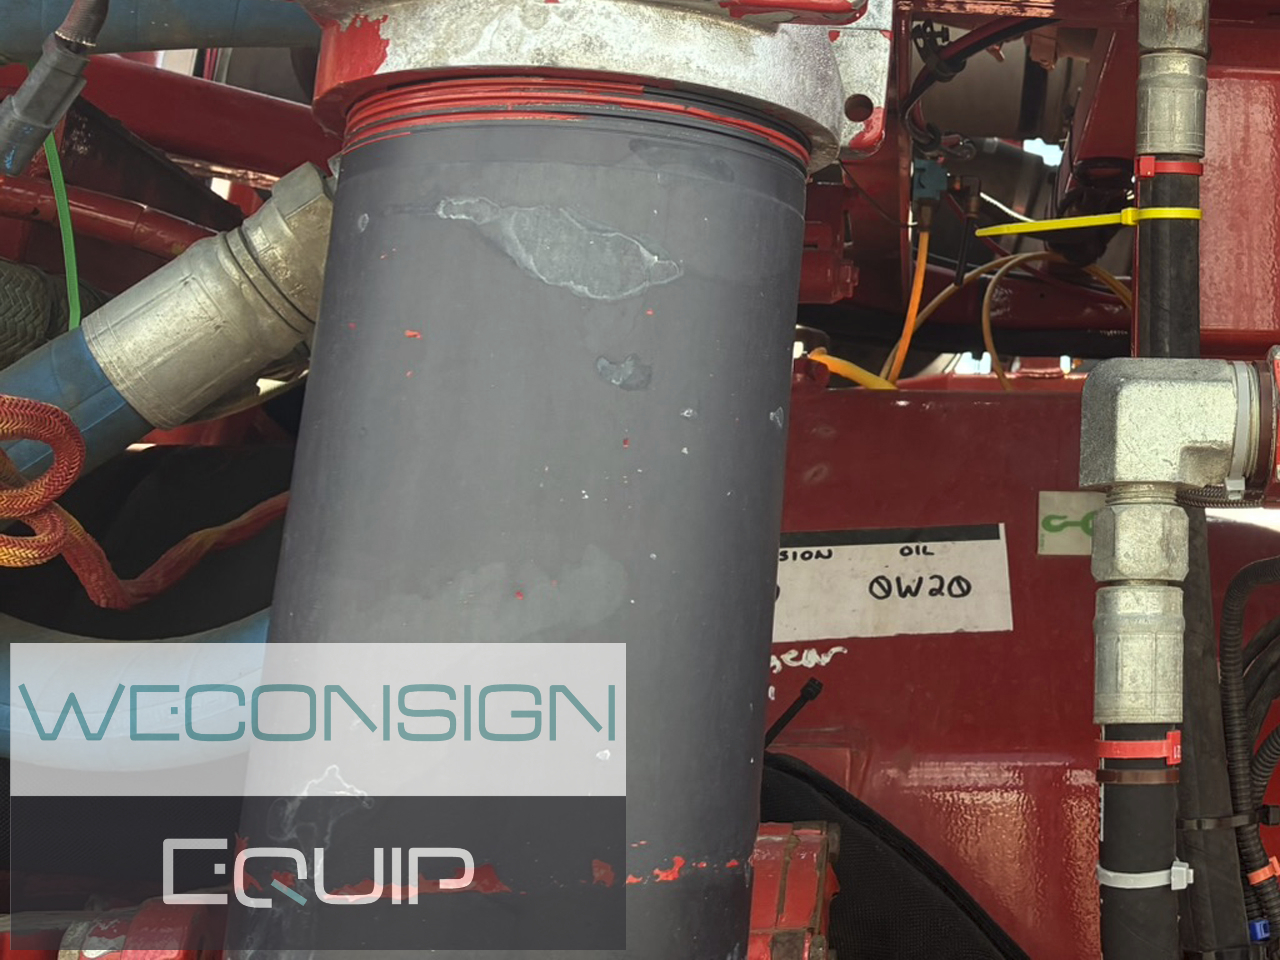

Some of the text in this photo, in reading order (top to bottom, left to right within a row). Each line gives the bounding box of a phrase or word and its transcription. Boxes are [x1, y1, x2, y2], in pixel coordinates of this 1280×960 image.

[778, 544, 935, 562] SION OIL
[868, 574, 972, 600] 0W20
